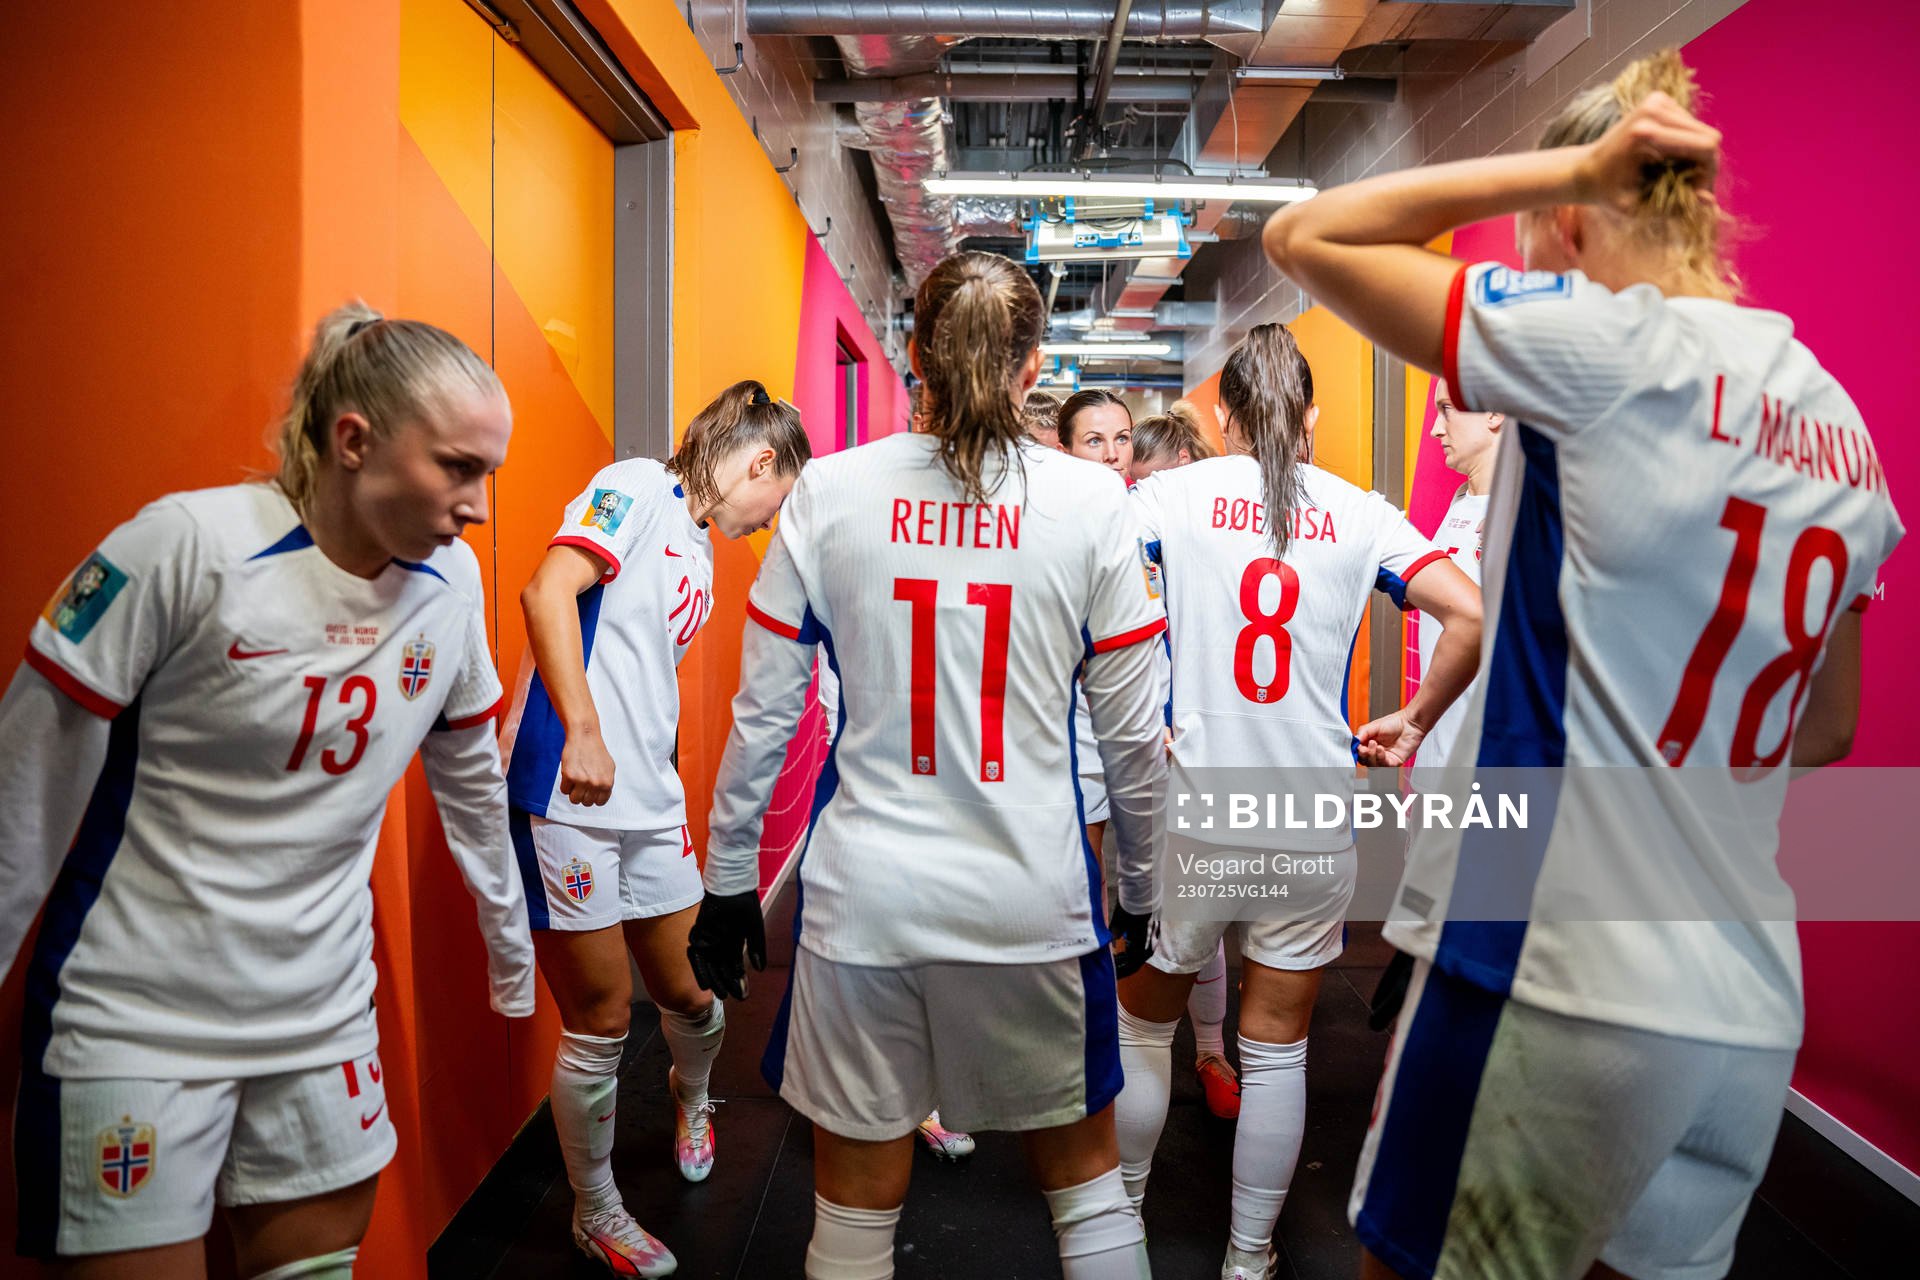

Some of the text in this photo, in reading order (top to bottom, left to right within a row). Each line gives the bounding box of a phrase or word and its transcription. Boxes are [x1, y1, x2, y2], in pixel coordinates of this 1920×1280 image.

[1711, 374, 1740, 447] L.
[891, 498, 1021, 550] REITEN
[668, 575, 703, 646] 20
[1233, 557, 1300, 704] 8
[1657, 496, 1848, 784] 18
[285, 675, 377, 776] 13
[893, 577, 1013, 783] 11
